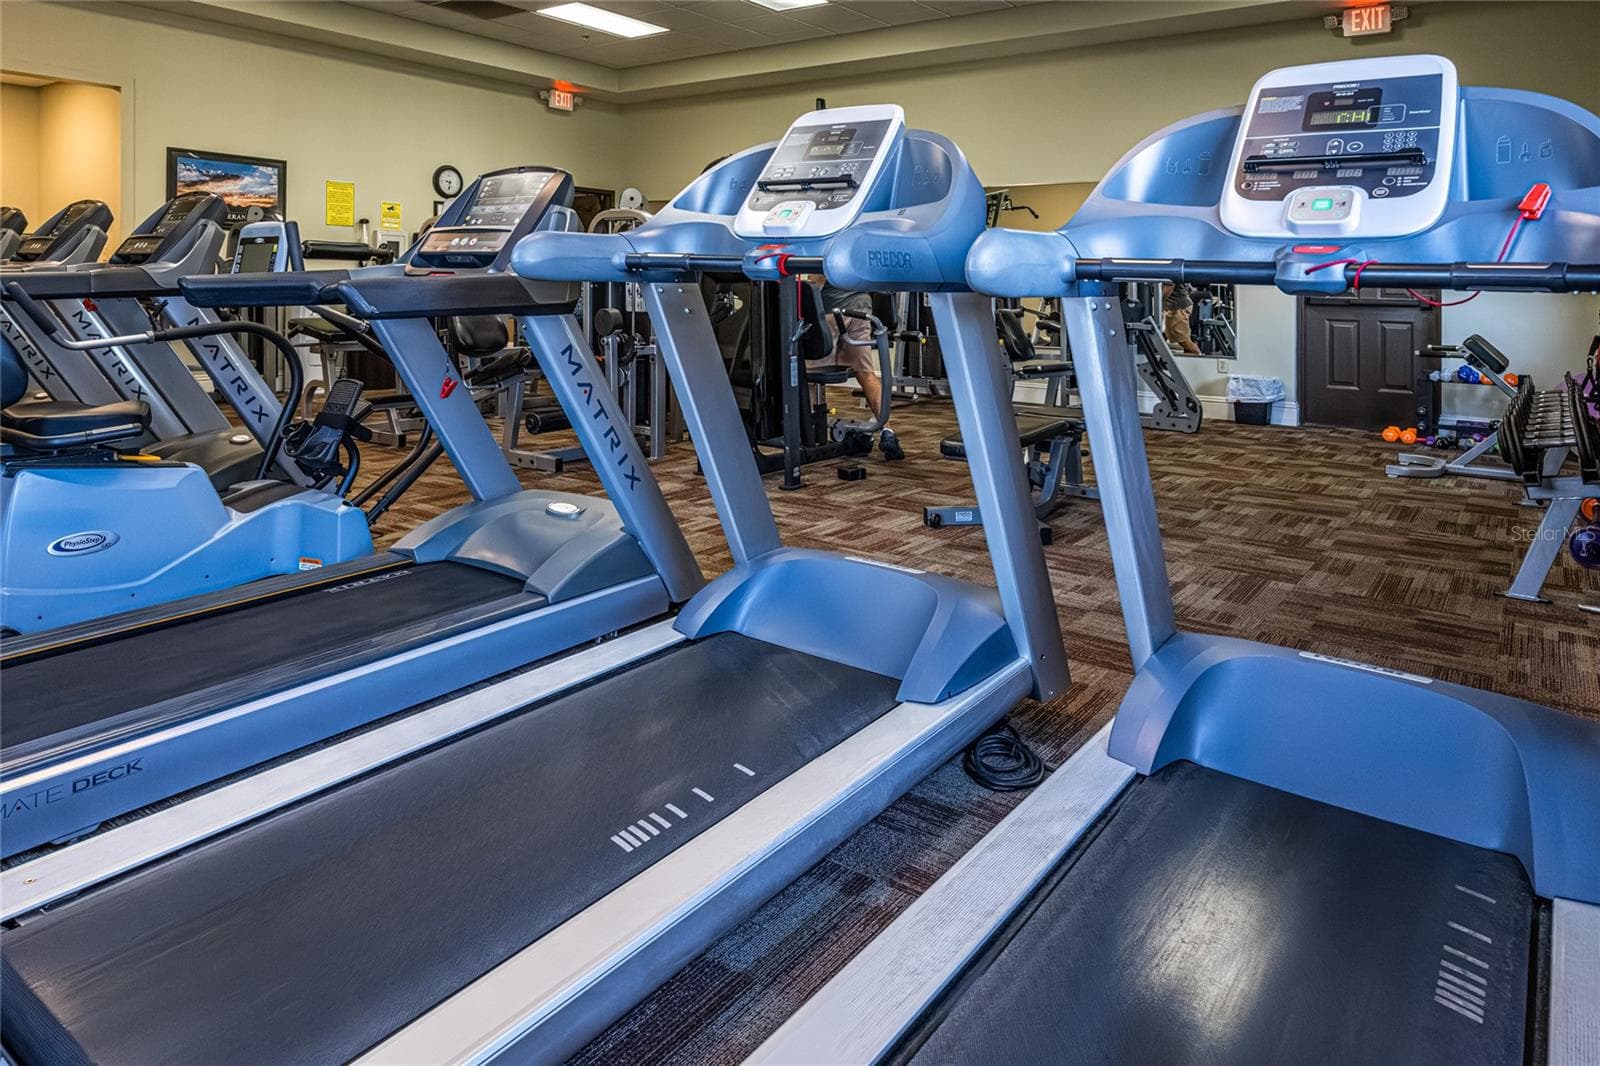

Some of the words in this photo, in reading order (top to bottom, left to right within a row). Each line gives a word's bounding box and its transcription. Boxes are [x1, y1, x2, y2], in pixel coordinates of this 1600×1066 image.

[1352, 8, 1385, 32] EXIT
[556, 91, 572, 108] EXIT
[868, 250, 912, 268] PRECOR
[0, 310, 56, 380] ATRIX
[561, 344, 642, 491] MATRIX
[64, 537, 100, 548] PhysioStep
[72, 757, 144, 793] DECK
